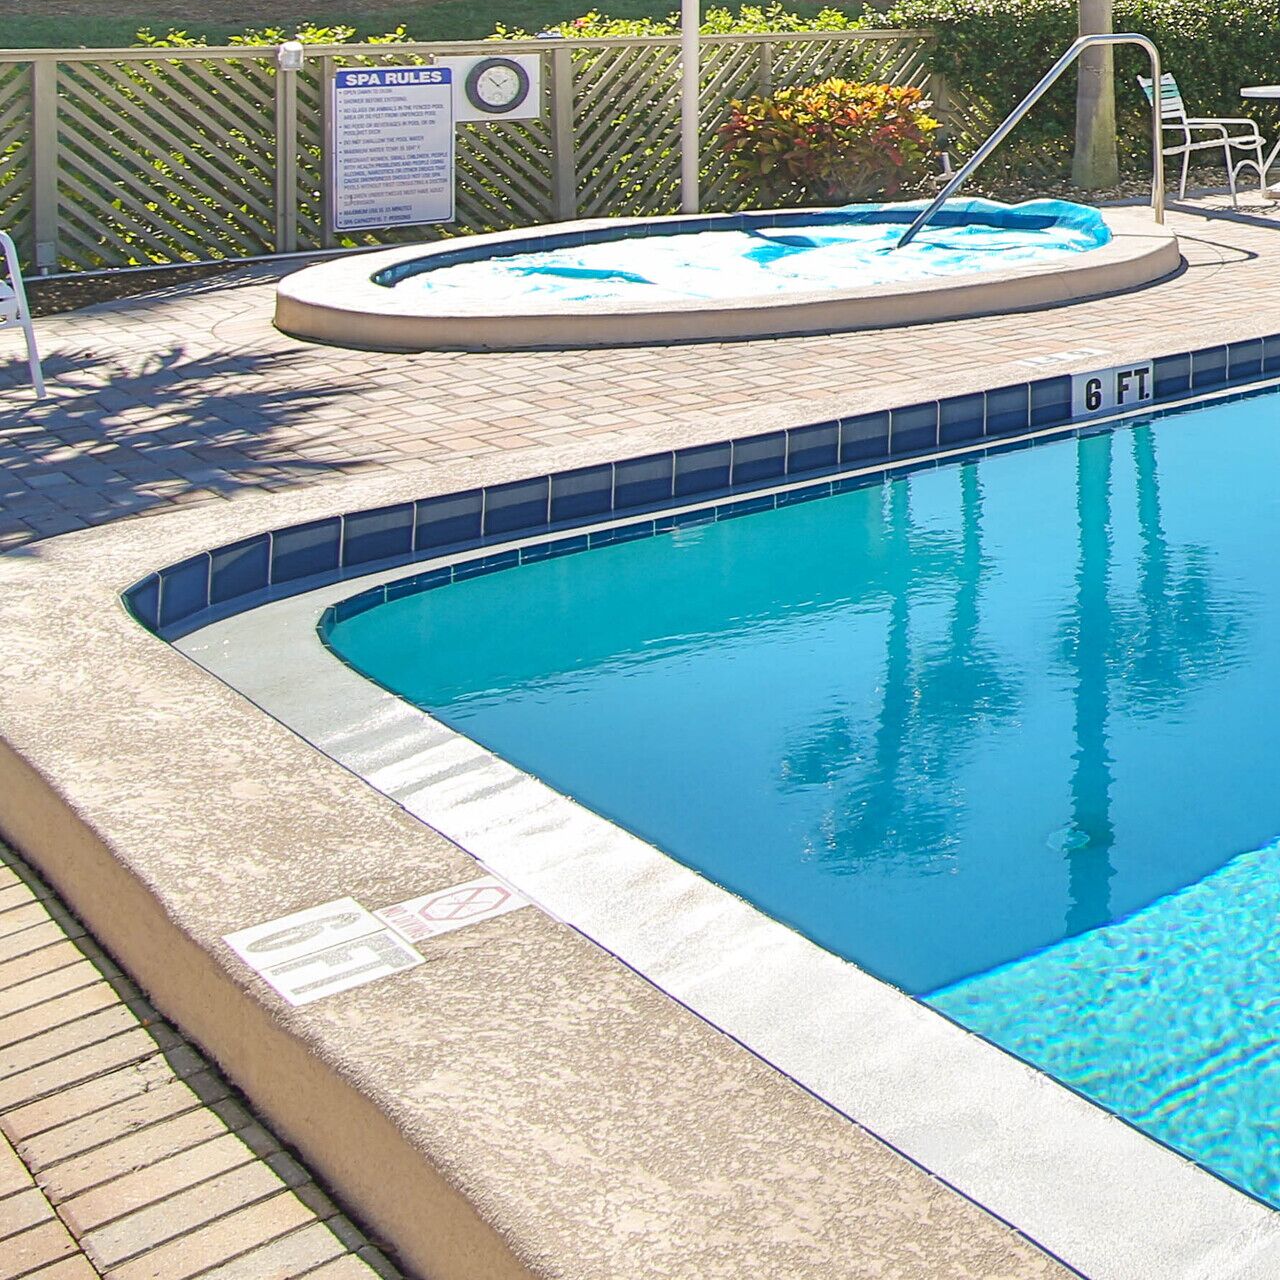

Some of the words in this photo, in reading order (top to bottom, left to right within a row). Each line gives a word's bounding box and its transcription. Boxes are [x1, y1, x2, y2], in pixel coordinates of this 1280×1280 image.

[345, 73, 381, 86] SPA
[385, 71, 443, 84] RULES
[1086, 378, 1102, 410] 6
[1117, 367, 1150, 405] FT.
[246, 912, 362, 953] 6
[271, 933, 419, 996] FT
